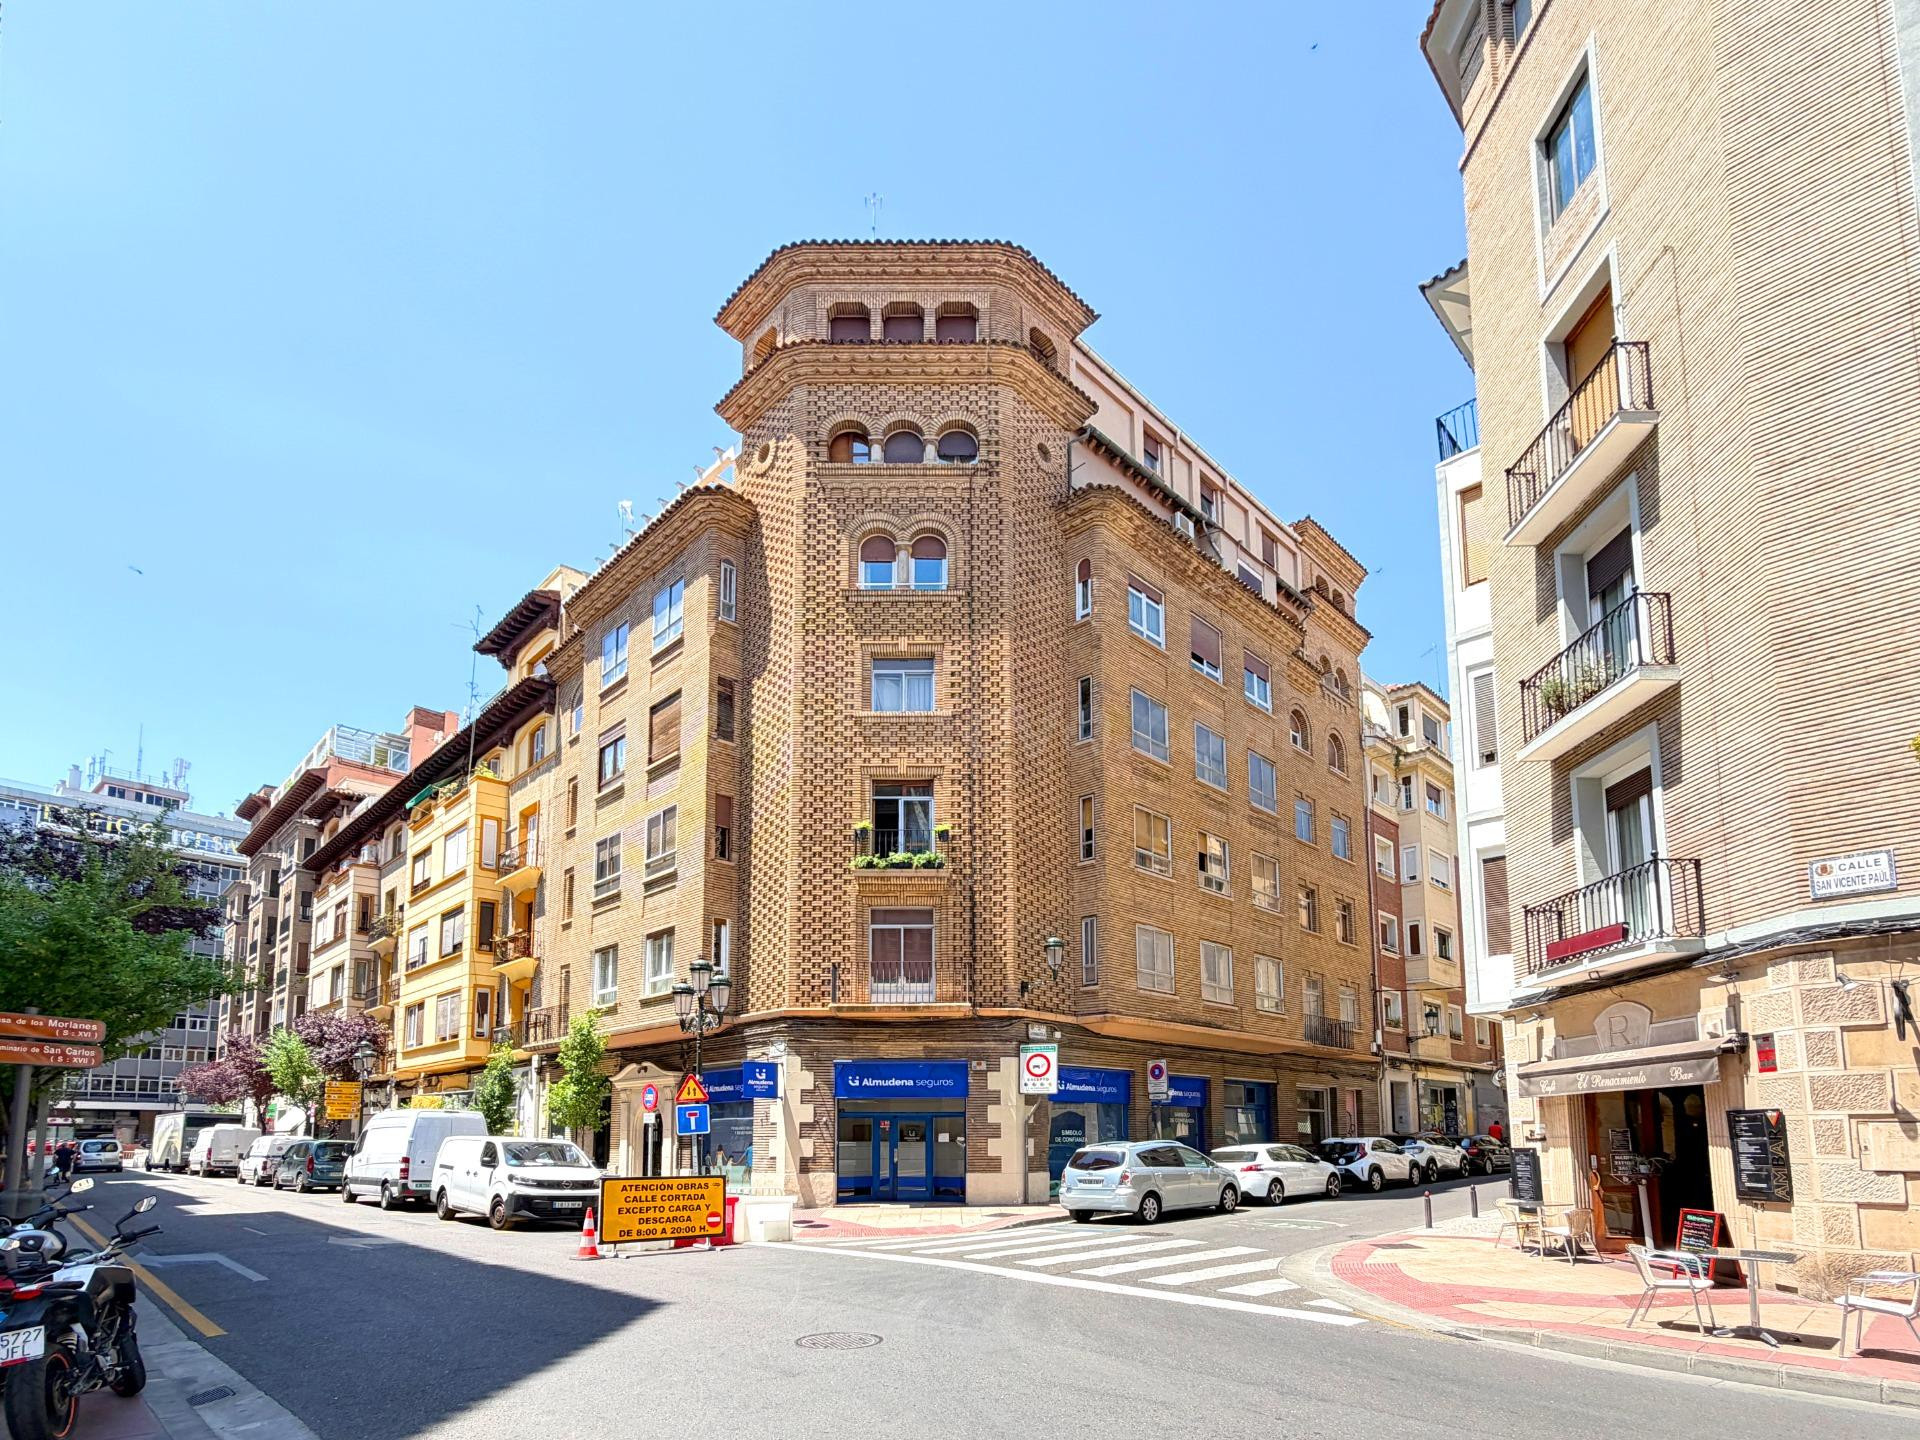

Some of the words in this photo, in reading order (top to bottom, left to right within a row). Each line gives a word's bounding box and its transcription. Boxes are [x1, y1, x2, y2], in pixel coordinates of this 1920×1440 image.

[48, 1019, 98, 1030] Morlanes
[43, 1045, 61, 1054] San
[65, 1047, 96, 1056] Carlos
[862, 1077, 914, 1087] Almudena
[915, 1078, 954, 1089] seguros
[1576, 1072, 1589, 1089] El
[1590, 1070, 1647, 1088] Renacimiento
[1669, 1066, 1694, 1081] Bar
[1066, 1082, 1096, 1092] Almudena
[1096, 1085, 1118, 1094] seguros
[620, 1182, 674, 1192] ATENCIÓN
[676, 1182, 709, 1190] OBRAS
[624, 1195, 657, 1203] CALLE
[660, 1193, 706, 1202] CORTADA
[618, 1205, 666, 1215] EXCEPTO
[668, 1204, 702, 1212] CARGA
[638, 1215, 692, 1225] DESCARGA
[619, 1229, 633, 1237] DE
[636, 1228, 658, 1236] 8:00
[670, 1226, 697, 1234] 20:00
[0, 1328, 42, 1348] 5727
[0, 1344, 31, 1361] JFL
